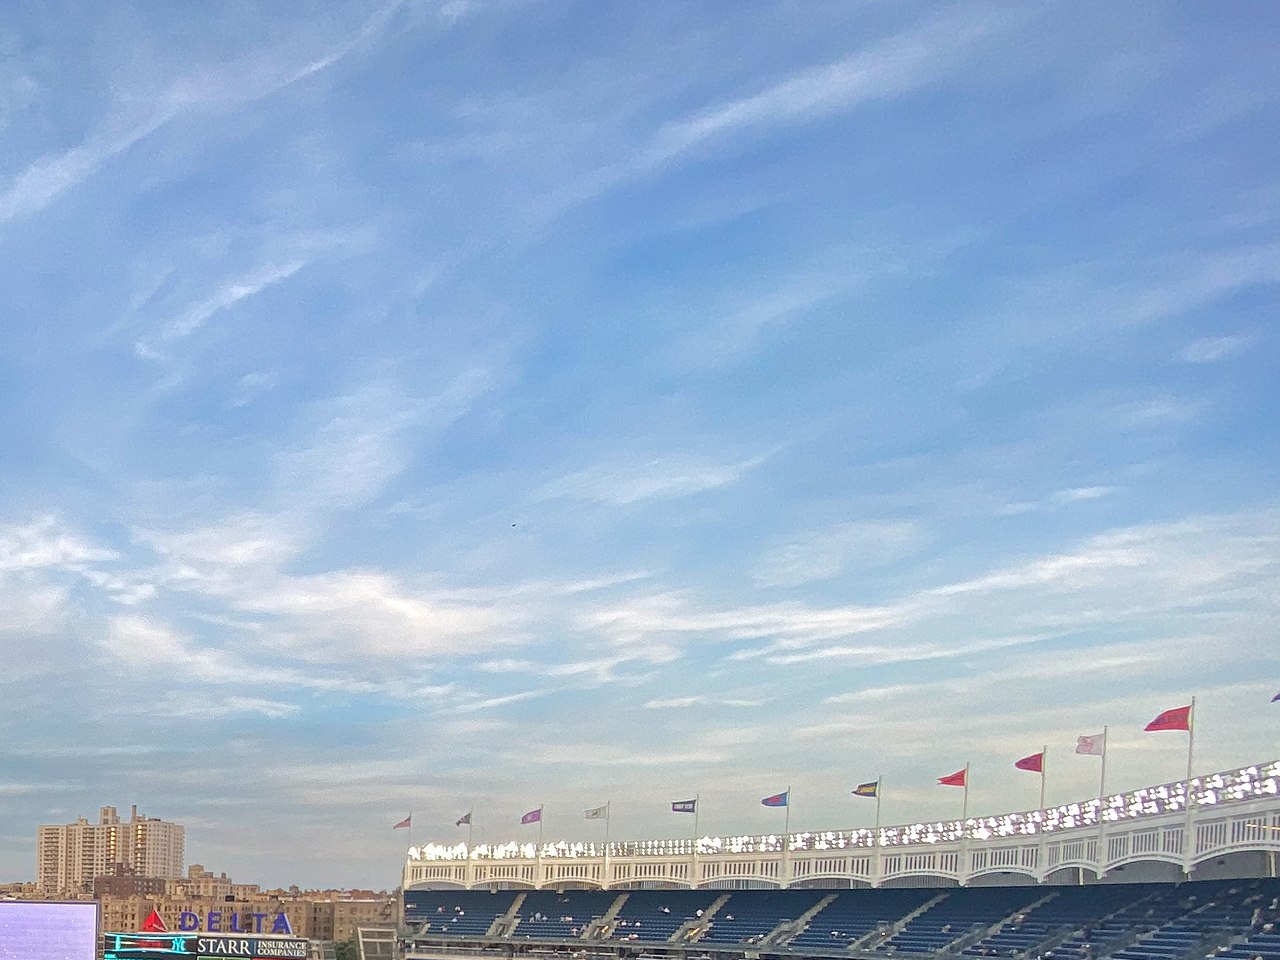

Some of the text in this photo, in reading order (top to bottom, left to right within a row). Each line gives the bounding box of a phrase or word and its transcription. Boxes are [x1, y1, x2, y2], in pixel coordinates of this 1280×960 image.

[180, 911, 294, 934] DELTA
[197, 939, 252, 955] STARR
[257, 940, 307, 950] INSURANCE
[257, 948, 307, 957] COMPANIES
